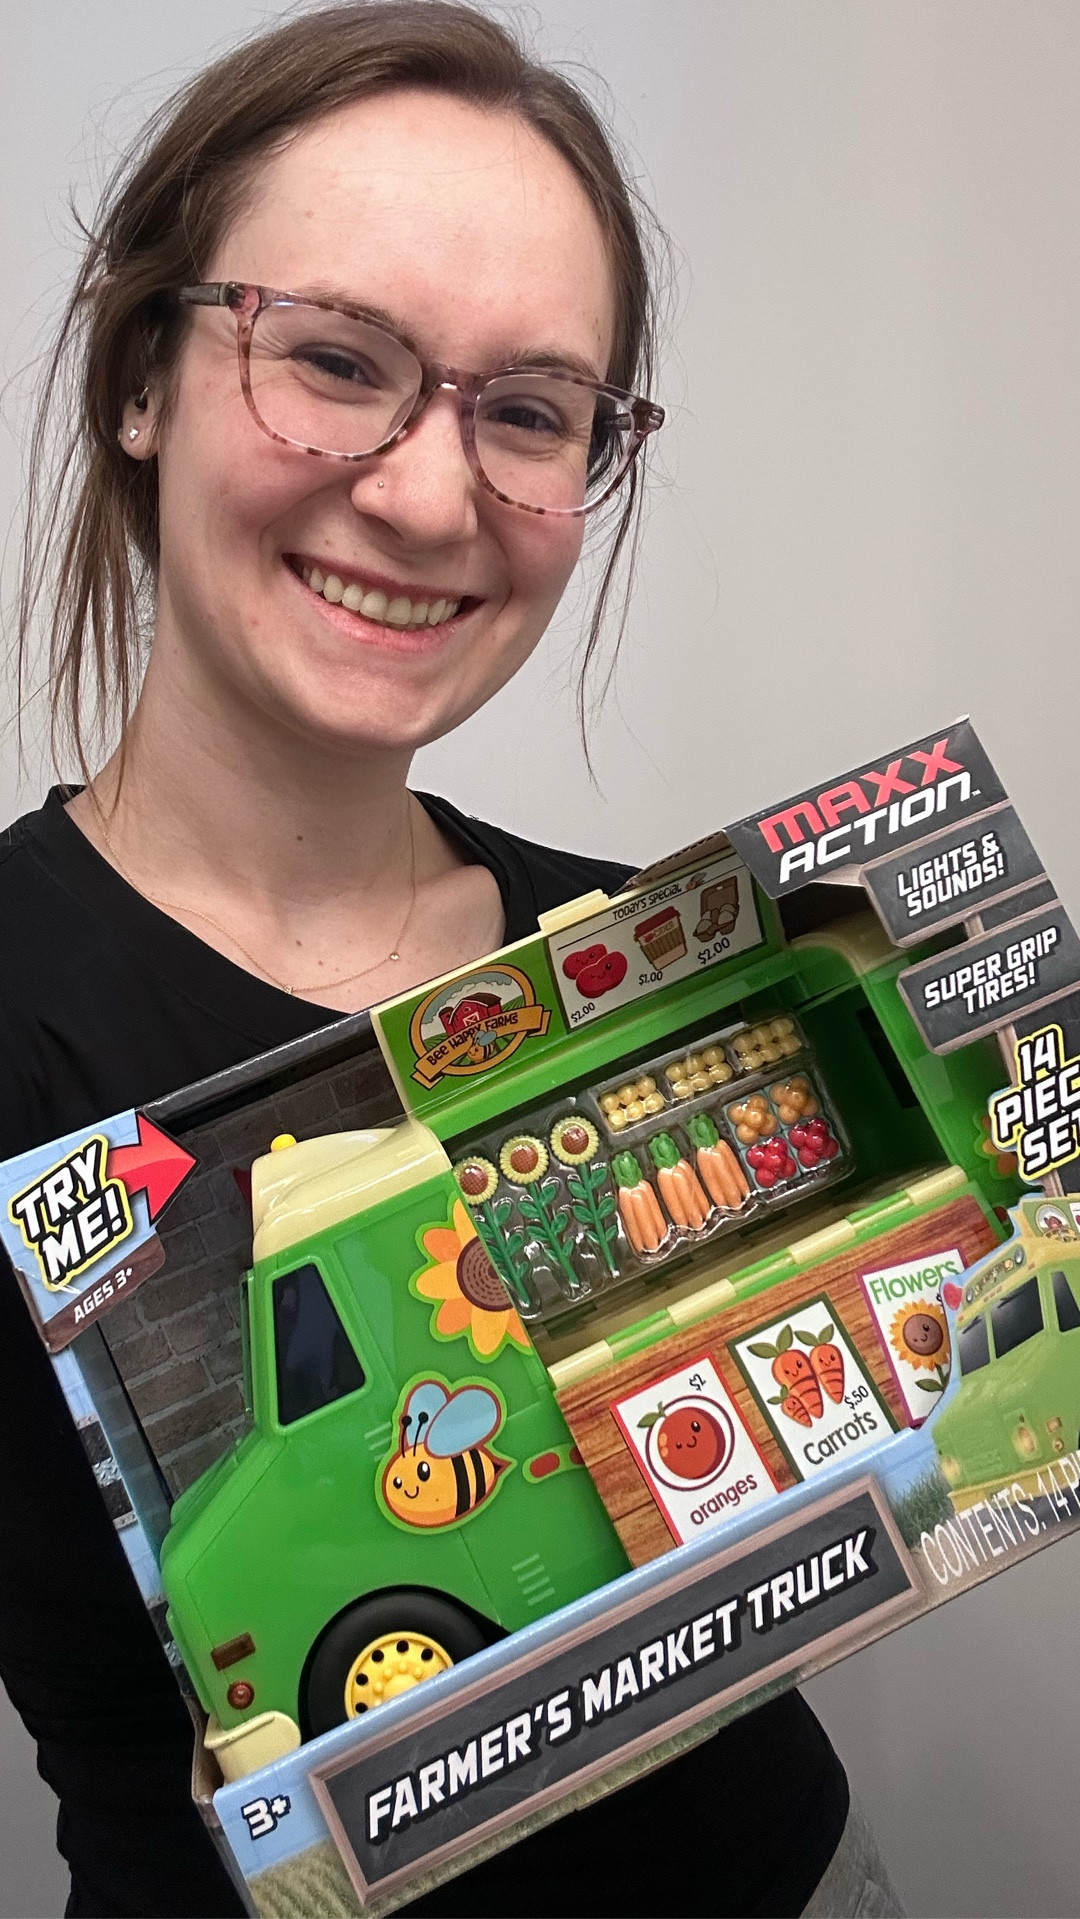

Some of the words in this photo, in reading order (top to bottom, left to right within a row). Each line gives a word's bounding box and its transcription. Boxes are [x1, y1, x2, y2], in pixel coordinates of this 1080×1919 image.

[758, 738, 964, 853] MAXX
[779, 771, 971, 883] ACTION
[897, 841, 979, 897] LIGHTS
[980, 832, 1000, 859] &
[907, 857, 1005, 917] SOUNDS!
[697, 937, 730, 964] $2.00
[924, 952, 1001, 1008] SUPER
[1006, 927, 1058, 976] GRIP
[639, 971, 663, 986] $1.00
[963, 965, 1036, 1014] TIRES!
[571, 1002, 595, 1023] $2.00
[1020, 1031, 1057, 1082] 14
[15, 1143, 97, 1239] TRY
[42, 1187, 122, 1281] ME!
[74, 1279, 114, 1323] AGES
[114, 1267, 133, 1289] 3+
[869, 1260, 960, 1305] Flowers
[689, 1373, 706, 1391] $2
[844, 1385, 869, 1410] $.50
[803, 1411, 878, 1465] Carrots
[690, 1474, 758, 1525] oranges
[921, 1483, 1047, 1585] CONTENTS:
[1037, 1465, 1072, 1522] 14
[369, 1690, 572, 1839] FARMER'S
[583, 1600, 738, 1722] MARKET
[747, 1531, 870, 1629] TRUCK
[242, 1796, 289, 1839] 3+
